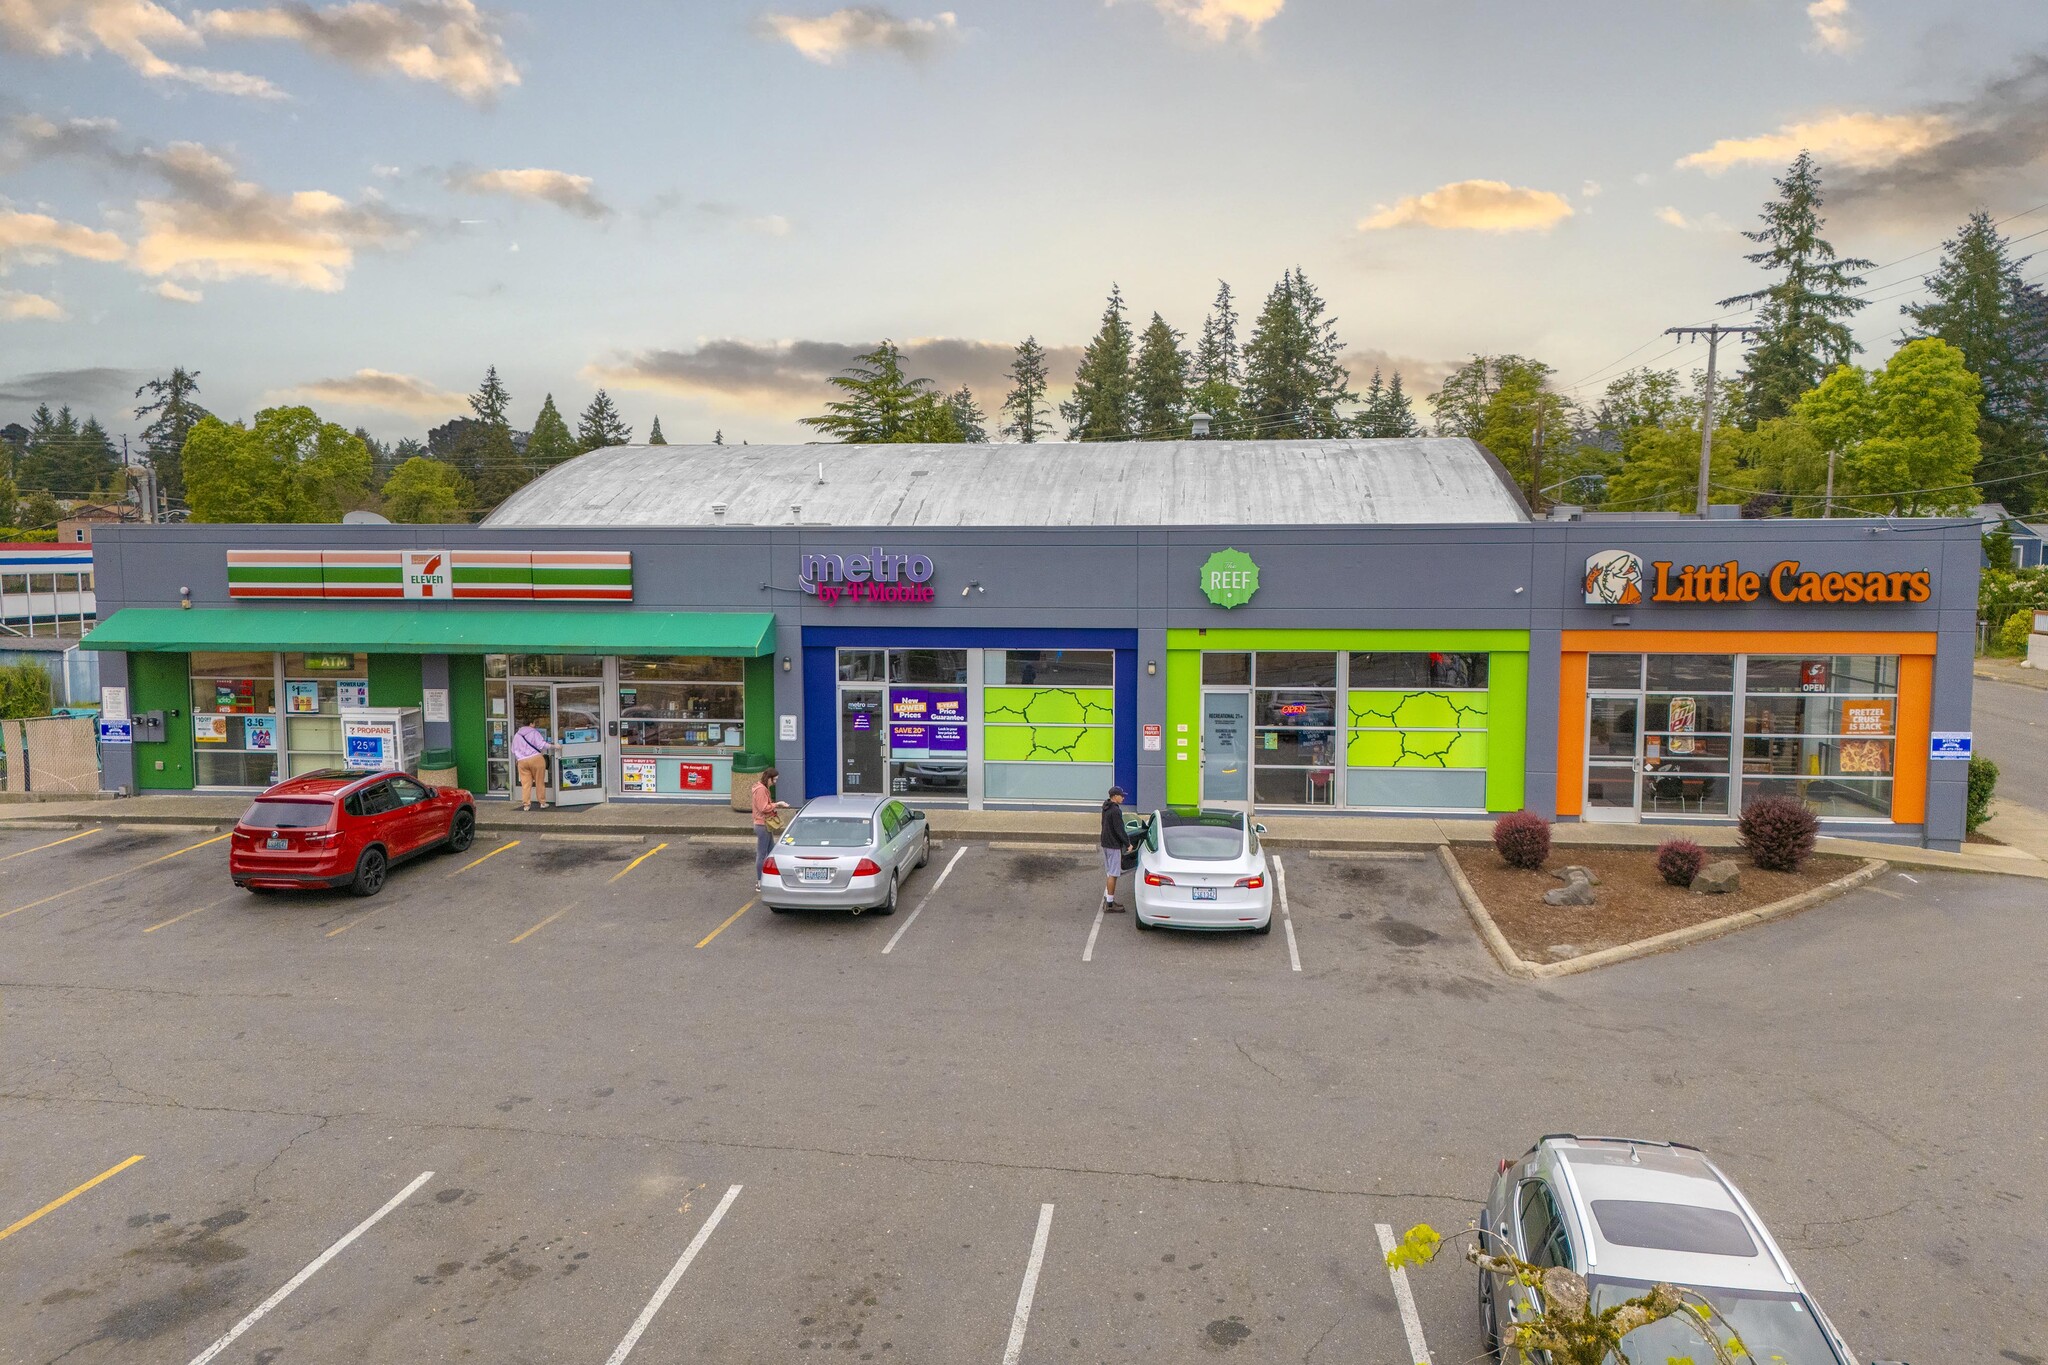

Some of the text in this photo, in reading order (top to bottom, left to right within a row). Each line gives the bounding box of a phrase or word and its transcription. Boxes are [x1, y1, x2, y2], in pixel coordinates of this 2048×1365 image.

[799, 547, 933, 588] metro
[422, 554, 441, 597] 7
[1211, 571, 1252, 590] REEF
[1652, 560, 1931, 602] Little Caesars
[818, 582, 842, 607] by
[321, 656, 347, 667] ATM
[1803, 684, 1825, 692] OPEN
[896, 704, 924, 712] LOWER
[1282, 704, 1306, 714] OPEN
[247, 718, 253, 726] 3
